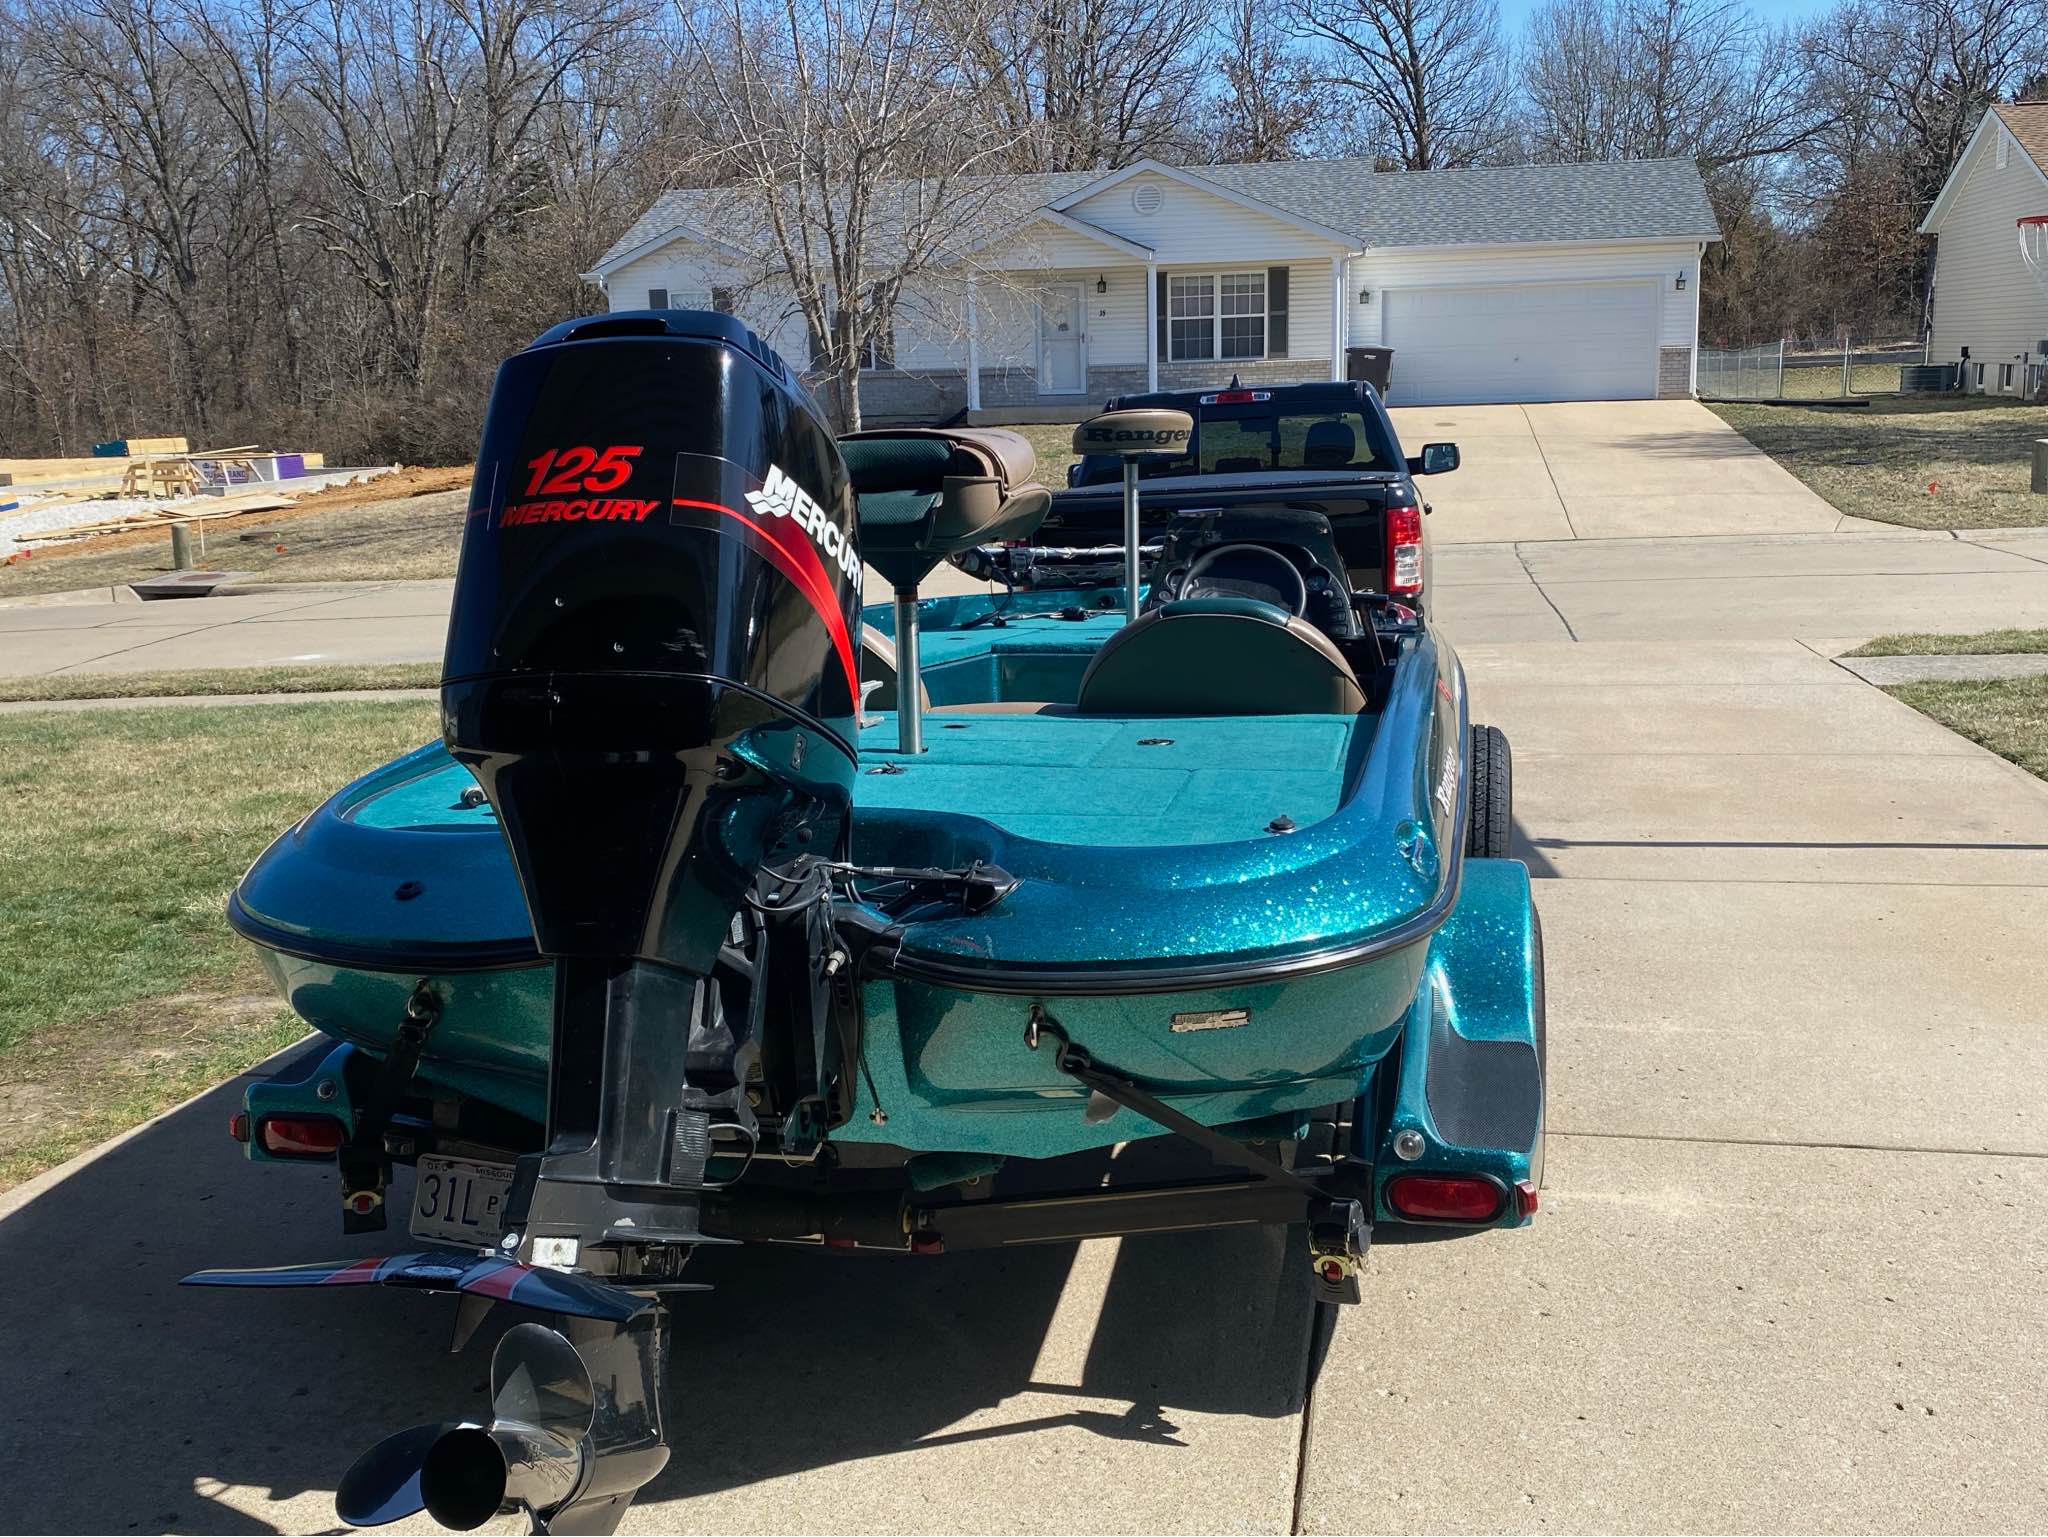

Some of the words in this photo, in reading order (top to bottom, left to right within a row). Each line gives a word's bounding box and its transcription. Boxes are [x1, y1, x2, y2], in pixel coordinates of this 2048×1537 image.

[1083, 428, 1192, 444] Ranger
[524, 445, 644, 496] 125
[500, 499, 661, 528] MERCURY
[761, 463, 863, 596] MERCURY
[475, 1167, 513, 1179] MISSOU
[419, 1173, 479, 1226] 31L
